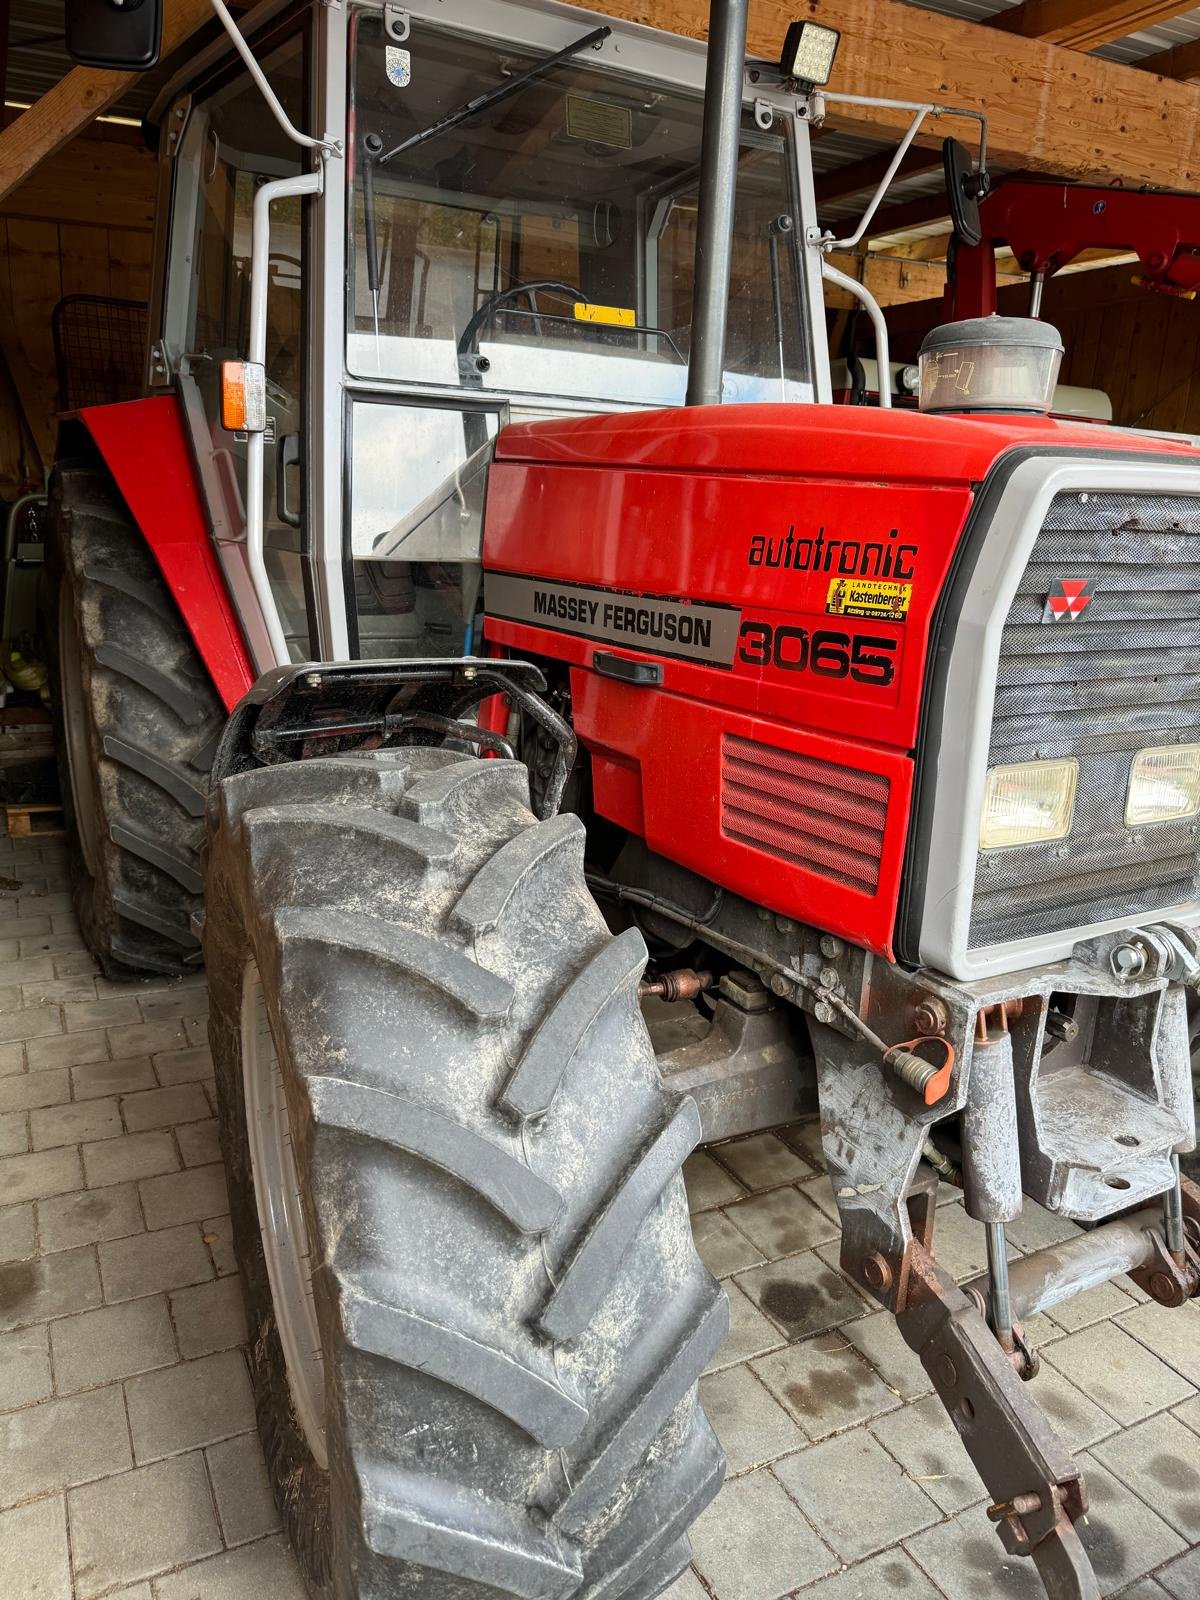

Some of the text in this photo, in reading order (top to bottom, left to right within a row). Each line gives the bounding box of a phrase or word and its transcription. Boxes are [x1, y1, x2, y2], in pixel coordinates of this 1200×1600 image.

[748, 525, 918, 580] autotronic
[851, 582, 907, 592] LANDTECHNK
[533, 591, 712, 648] MASSEY FERGUSON
[738, 620, 898, 687] 3065
